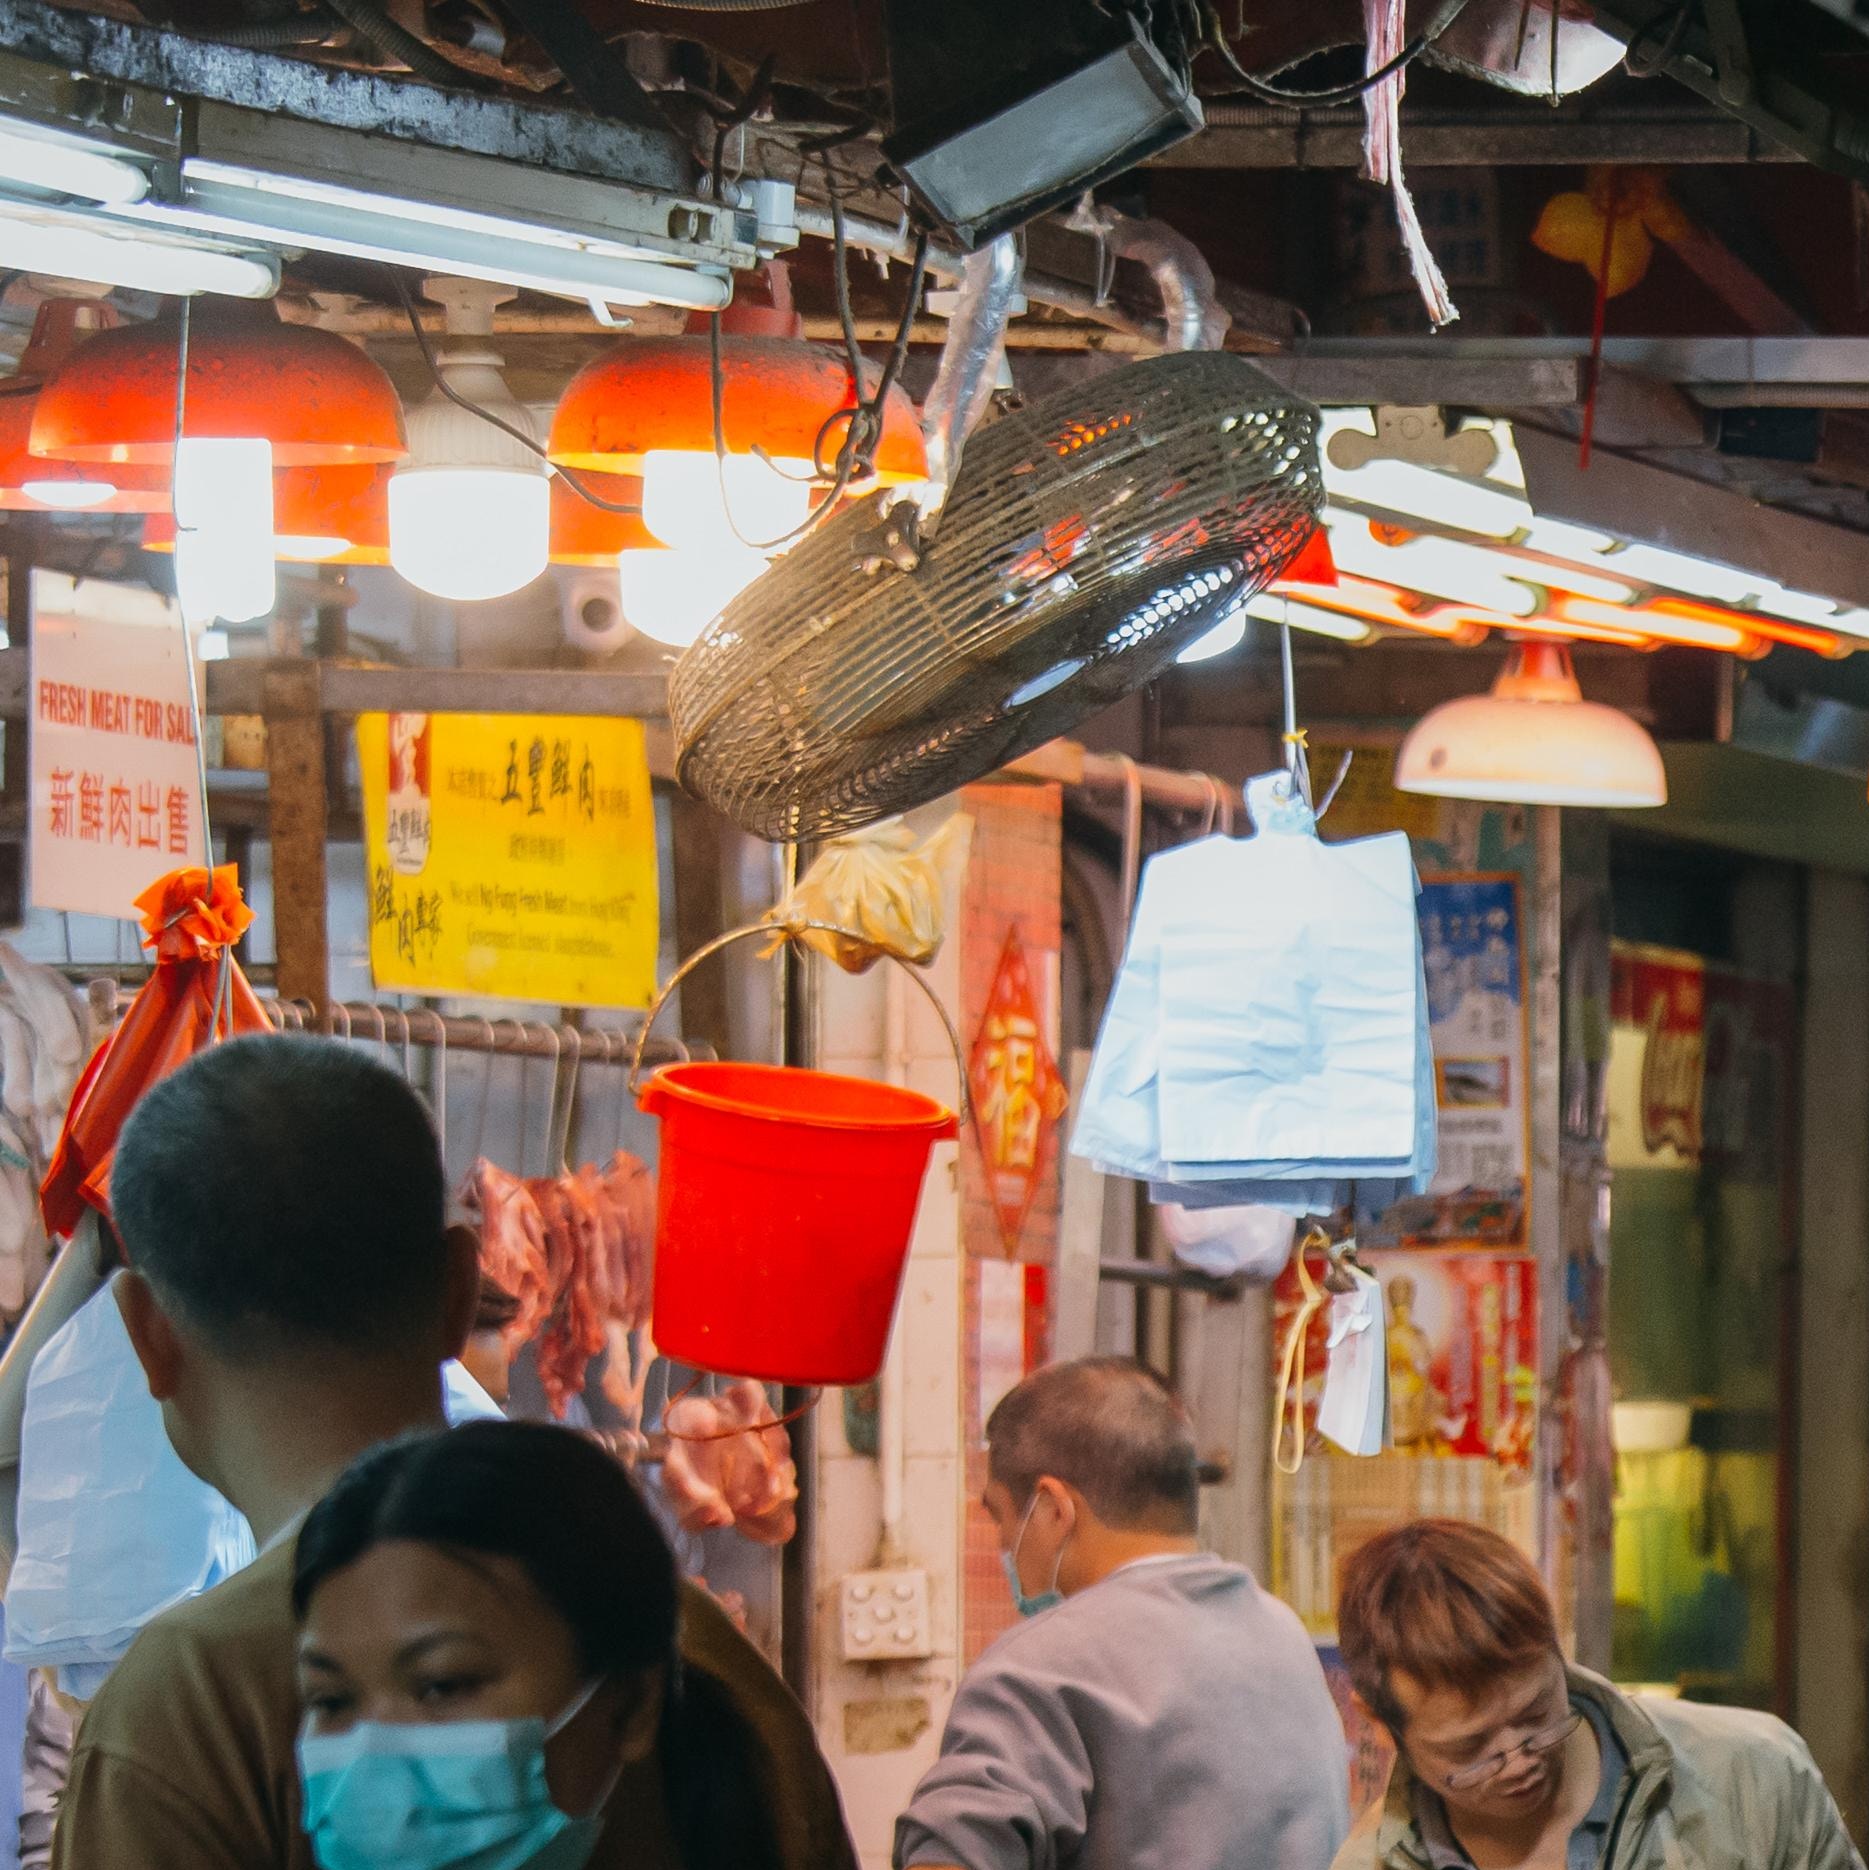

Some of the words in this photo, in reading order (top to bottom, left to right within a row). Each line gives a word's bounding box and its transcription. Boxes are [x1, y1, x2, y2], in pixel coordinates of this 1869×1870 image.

[39, 680, 86, 727] FRESH
[91, 688, 131, 736] MEAT
[134, 697, 164, 741] FOR
[167, 703, 202, 747] SAL
[50, 766, 190, 855] 新鮮肉出售
[981, 1014, 1042, 1169] 福
